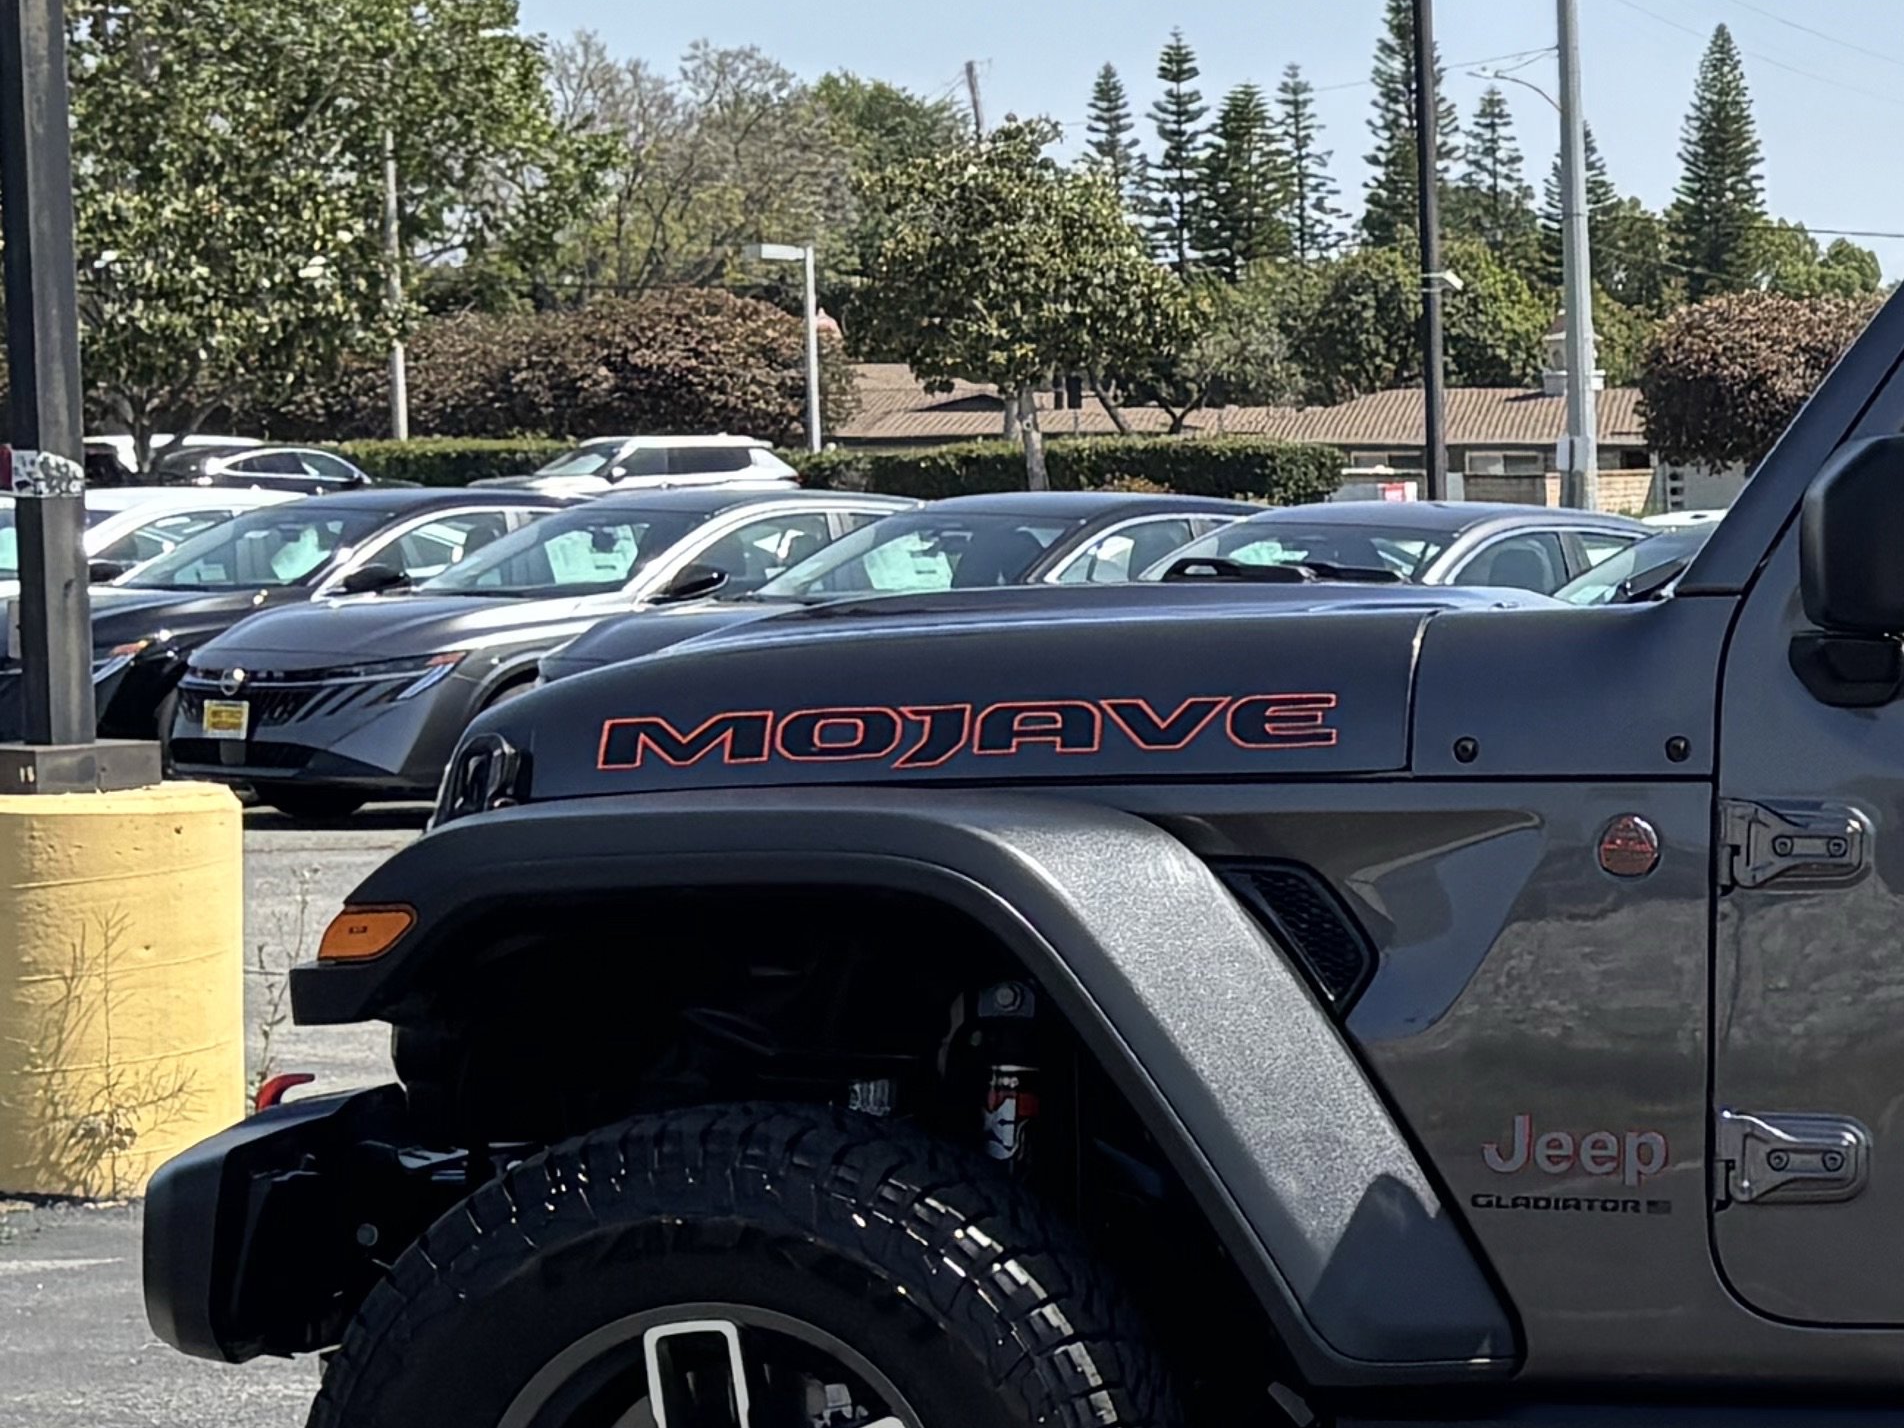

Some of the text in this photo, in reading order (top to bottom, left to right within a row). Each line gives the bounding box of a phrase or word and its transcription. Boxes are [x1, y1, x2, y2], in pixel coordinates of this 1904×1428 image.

[596, 693, 1337, 769] MOJAVE
[1481, 1113, 1670, 1187] Jeep
[1470, 1193, 1642, 1214] GLADIATOR
